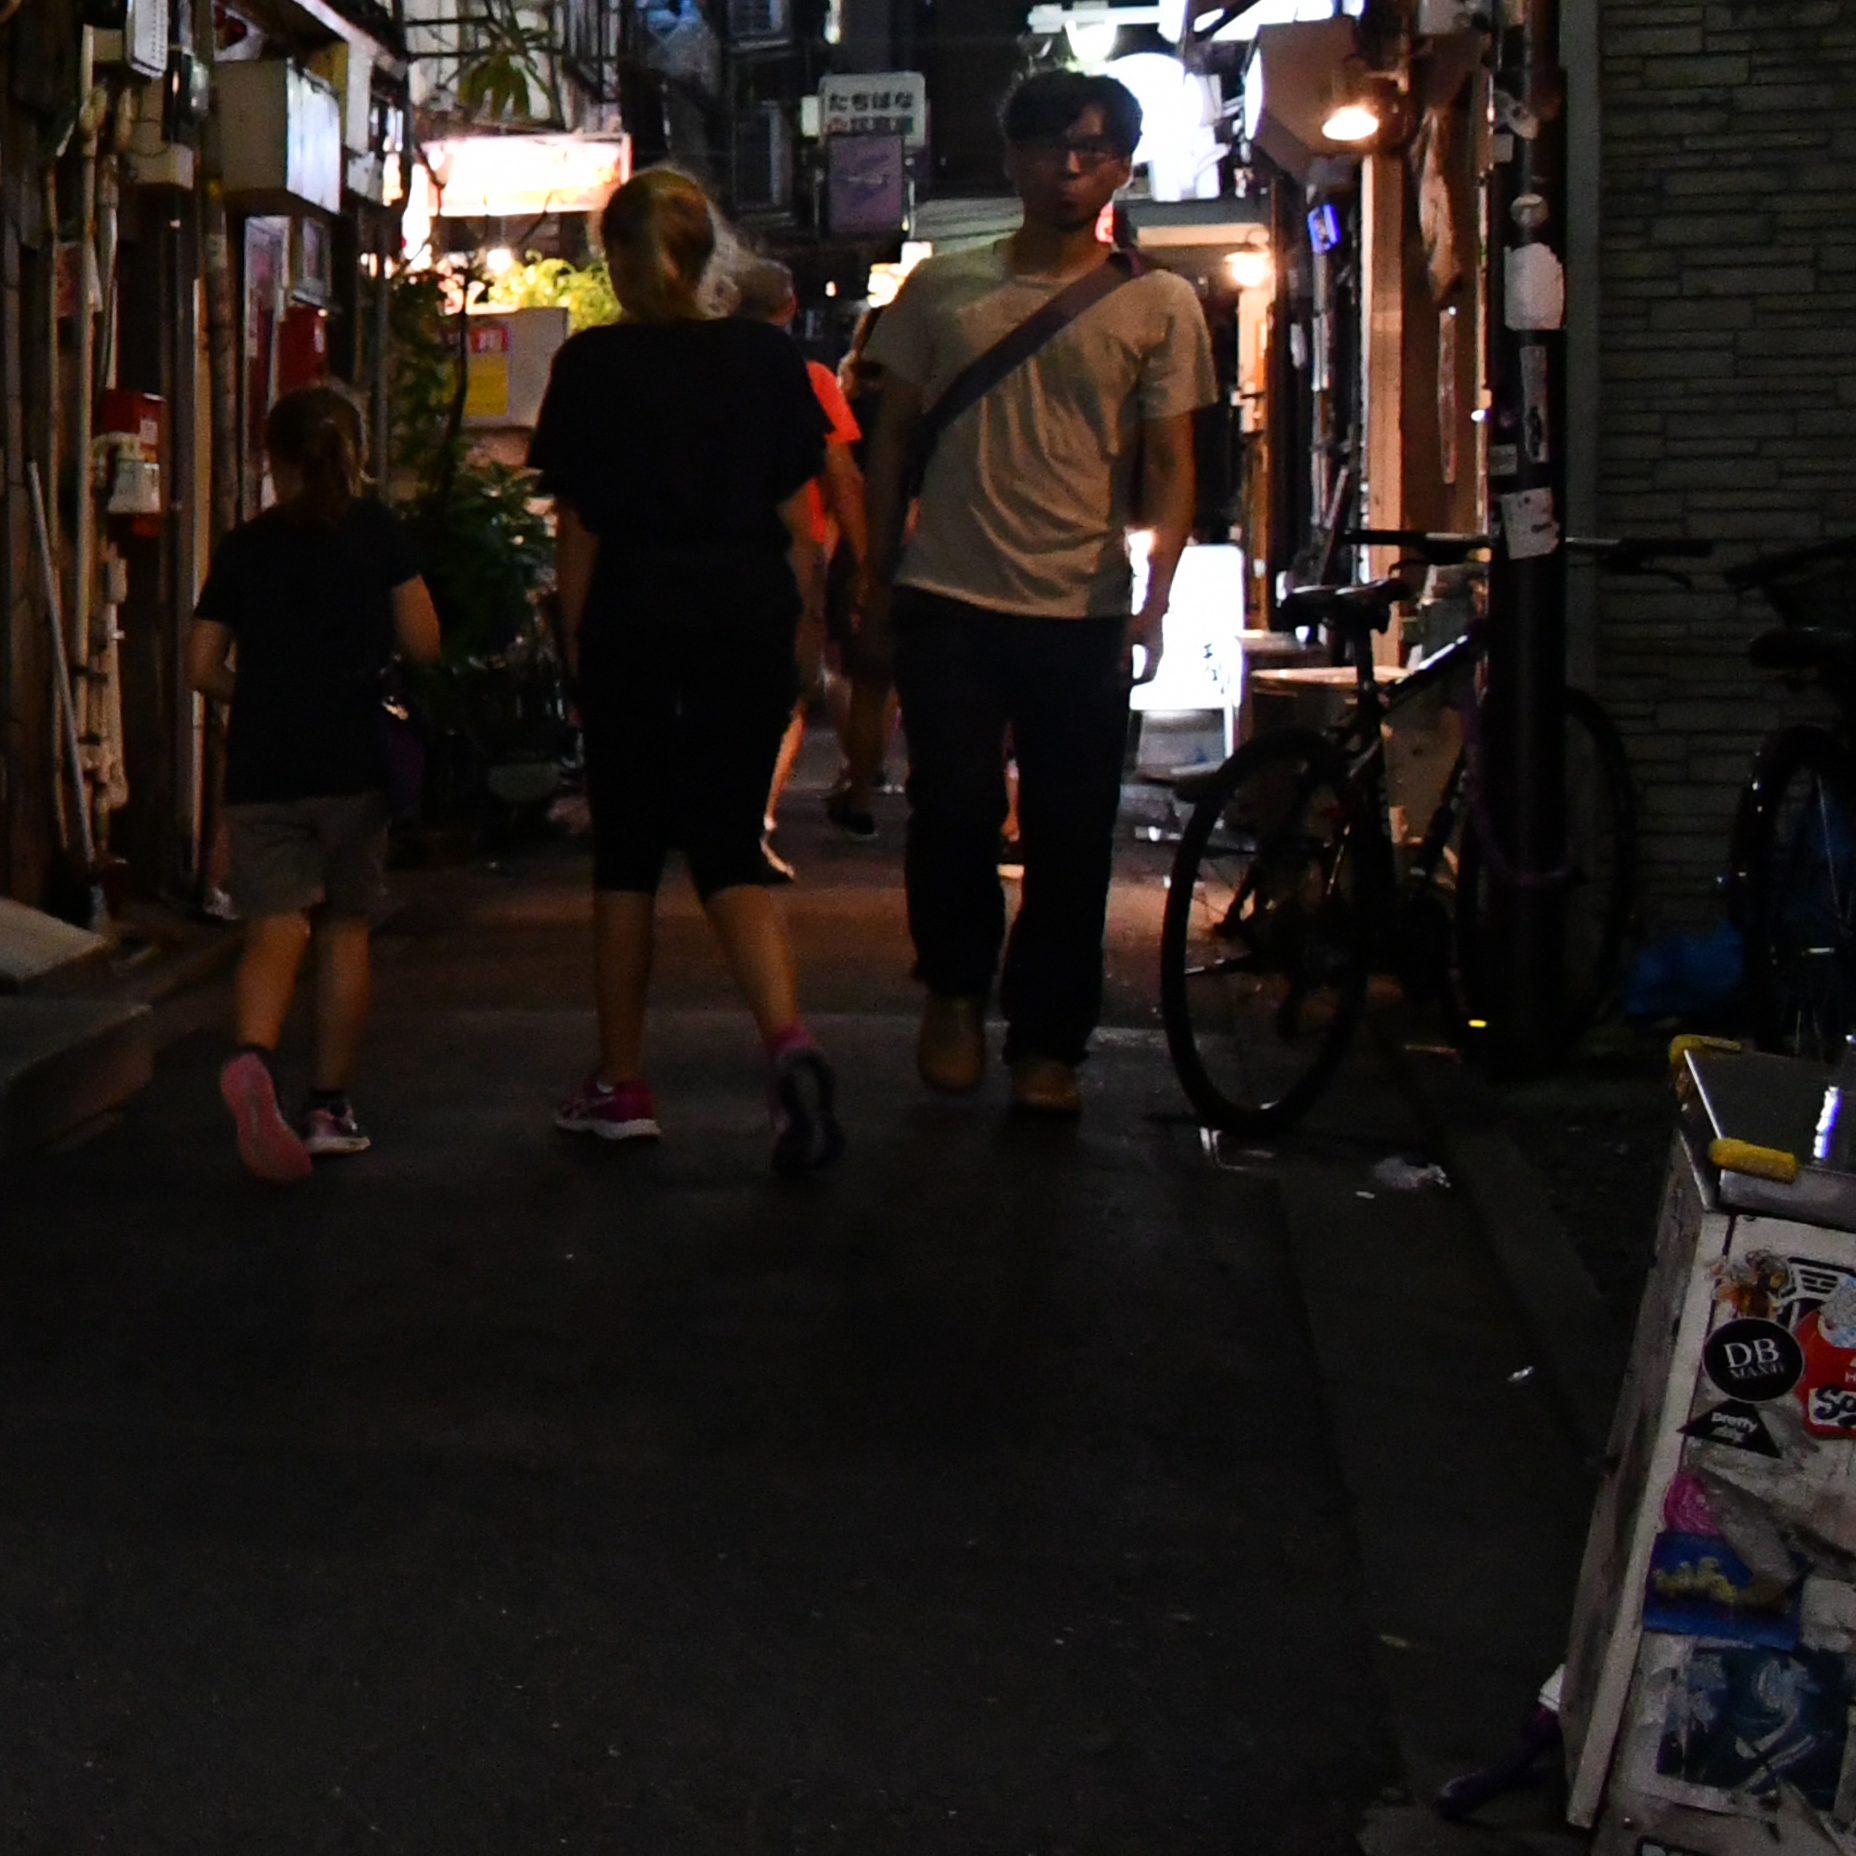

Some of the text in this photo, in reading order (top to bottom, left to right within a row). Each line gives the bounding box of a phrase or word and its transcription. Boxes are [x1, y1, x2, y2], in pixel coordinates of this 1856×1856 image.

[829, 91, 914, 112] たちばな
[1723, 1337, 1781, 1369] DB
